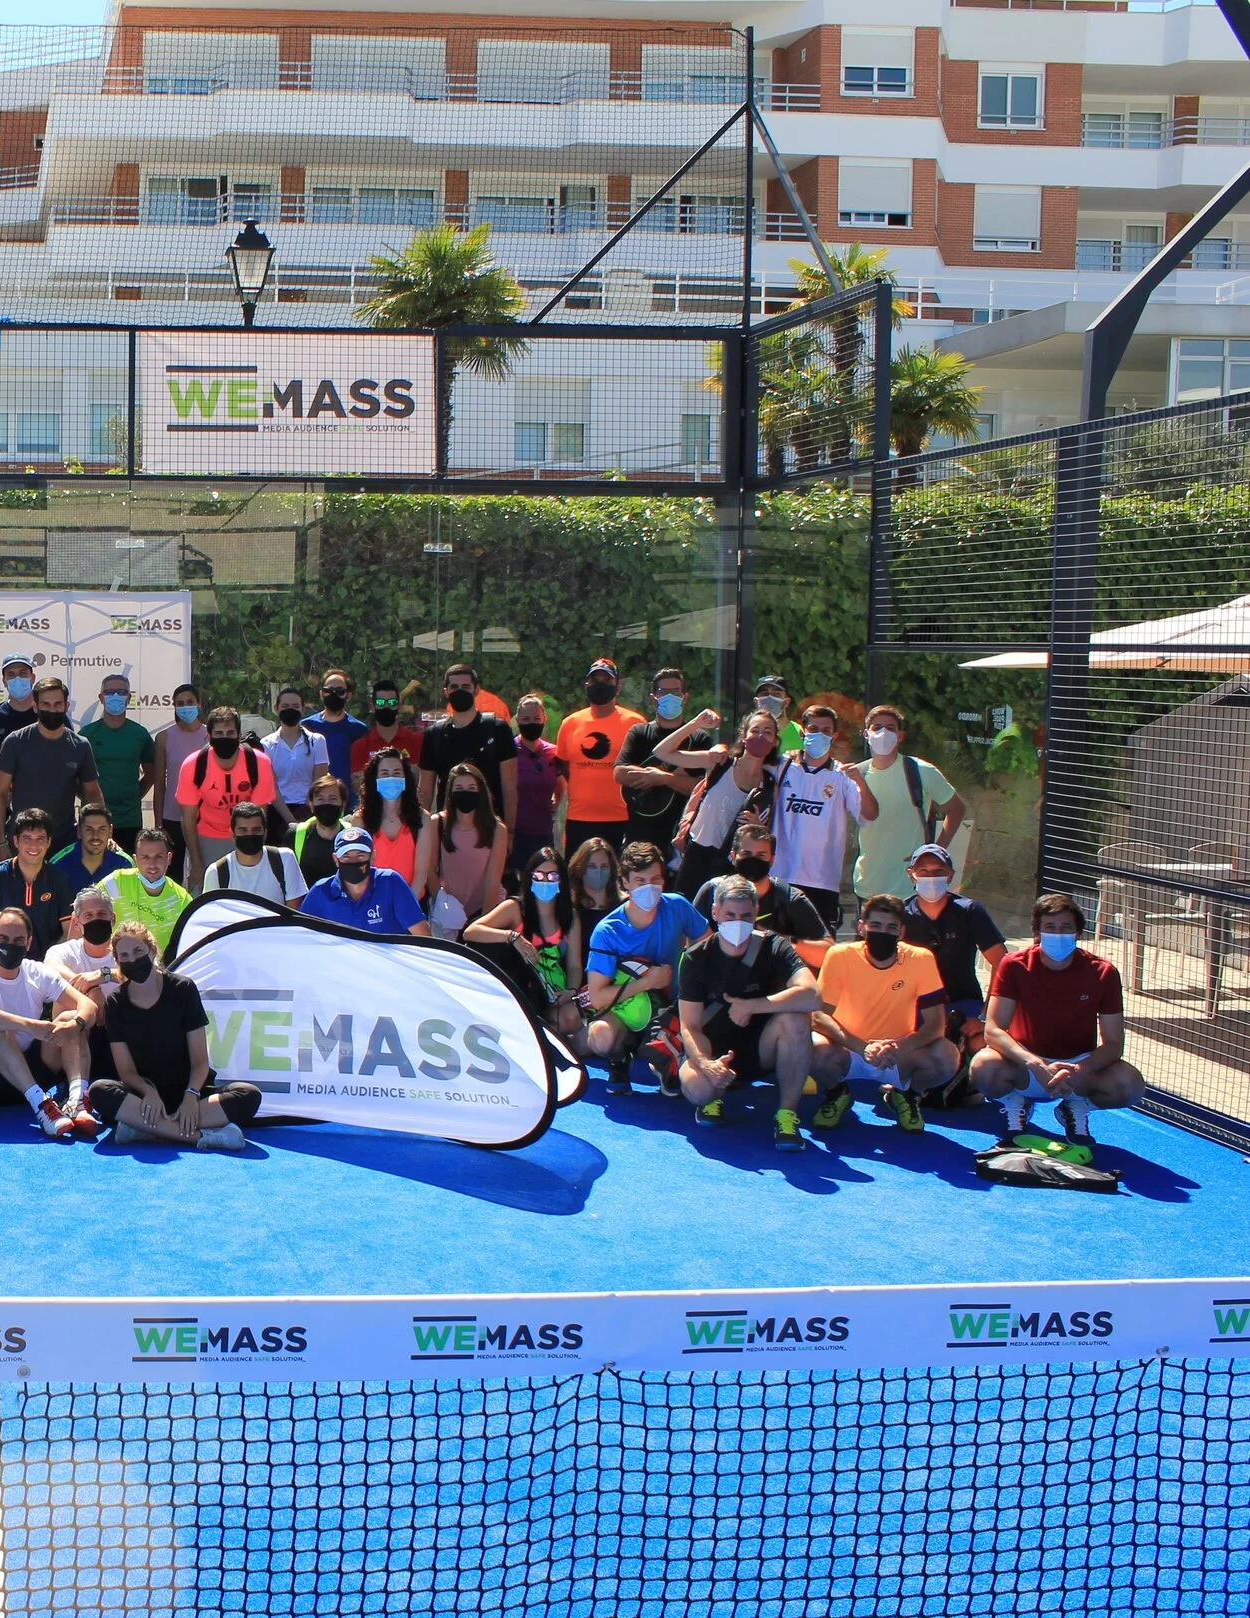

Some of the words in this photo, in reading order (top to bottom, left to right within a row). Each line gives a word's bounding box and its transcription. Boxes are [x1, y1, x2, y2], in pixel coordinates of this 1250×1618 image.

[50, 654, 122, 667] Permutive
[297, 1084, 337, 1096] MEDIA
[340, 1085, 406, 1098] AUDIENCE
[409, 1088, 442, 1101] SAFE
